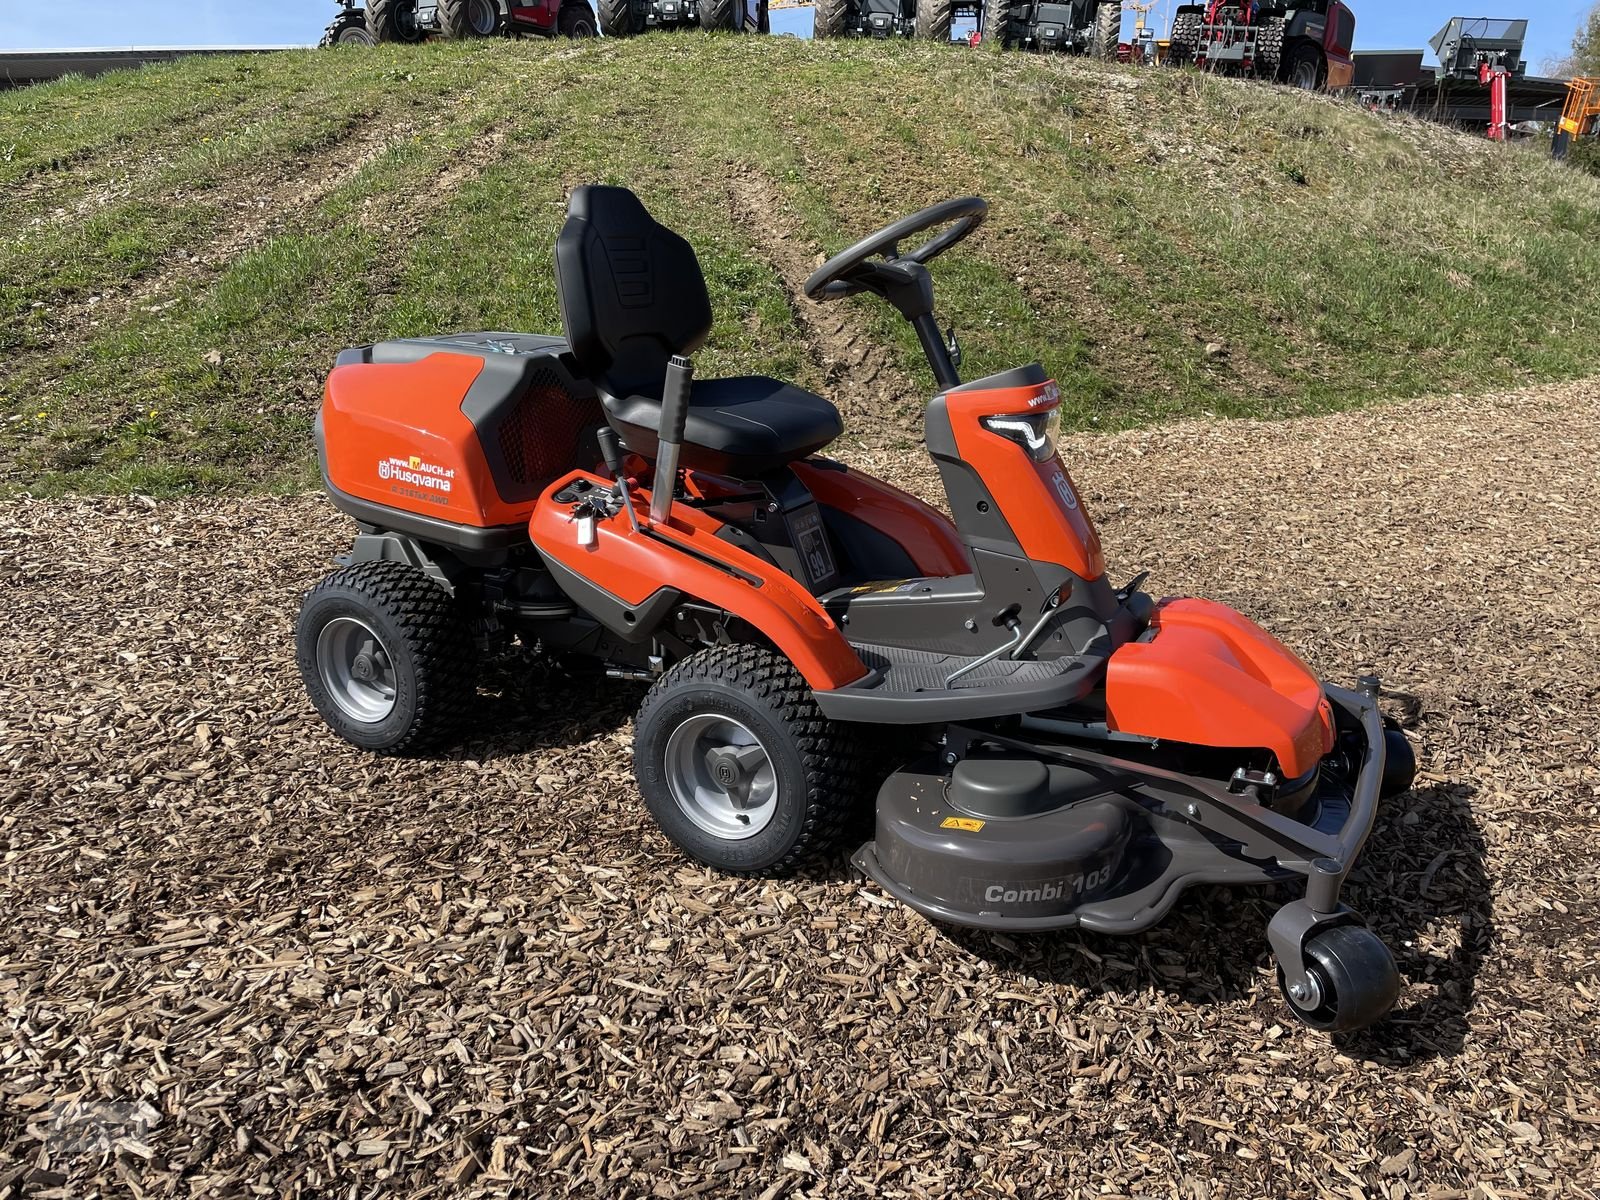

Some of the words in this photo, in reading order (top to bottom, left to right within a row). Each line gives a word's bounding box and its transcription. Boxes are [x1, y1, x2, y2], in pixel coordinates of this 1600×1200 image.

[389, 457, 454, 478] www.MAUCH.at
[390, 465, 451, 492] Husqvarna
[984, 881, 1063, 902] Combi
[1072, 865, 1111, 893] 103
